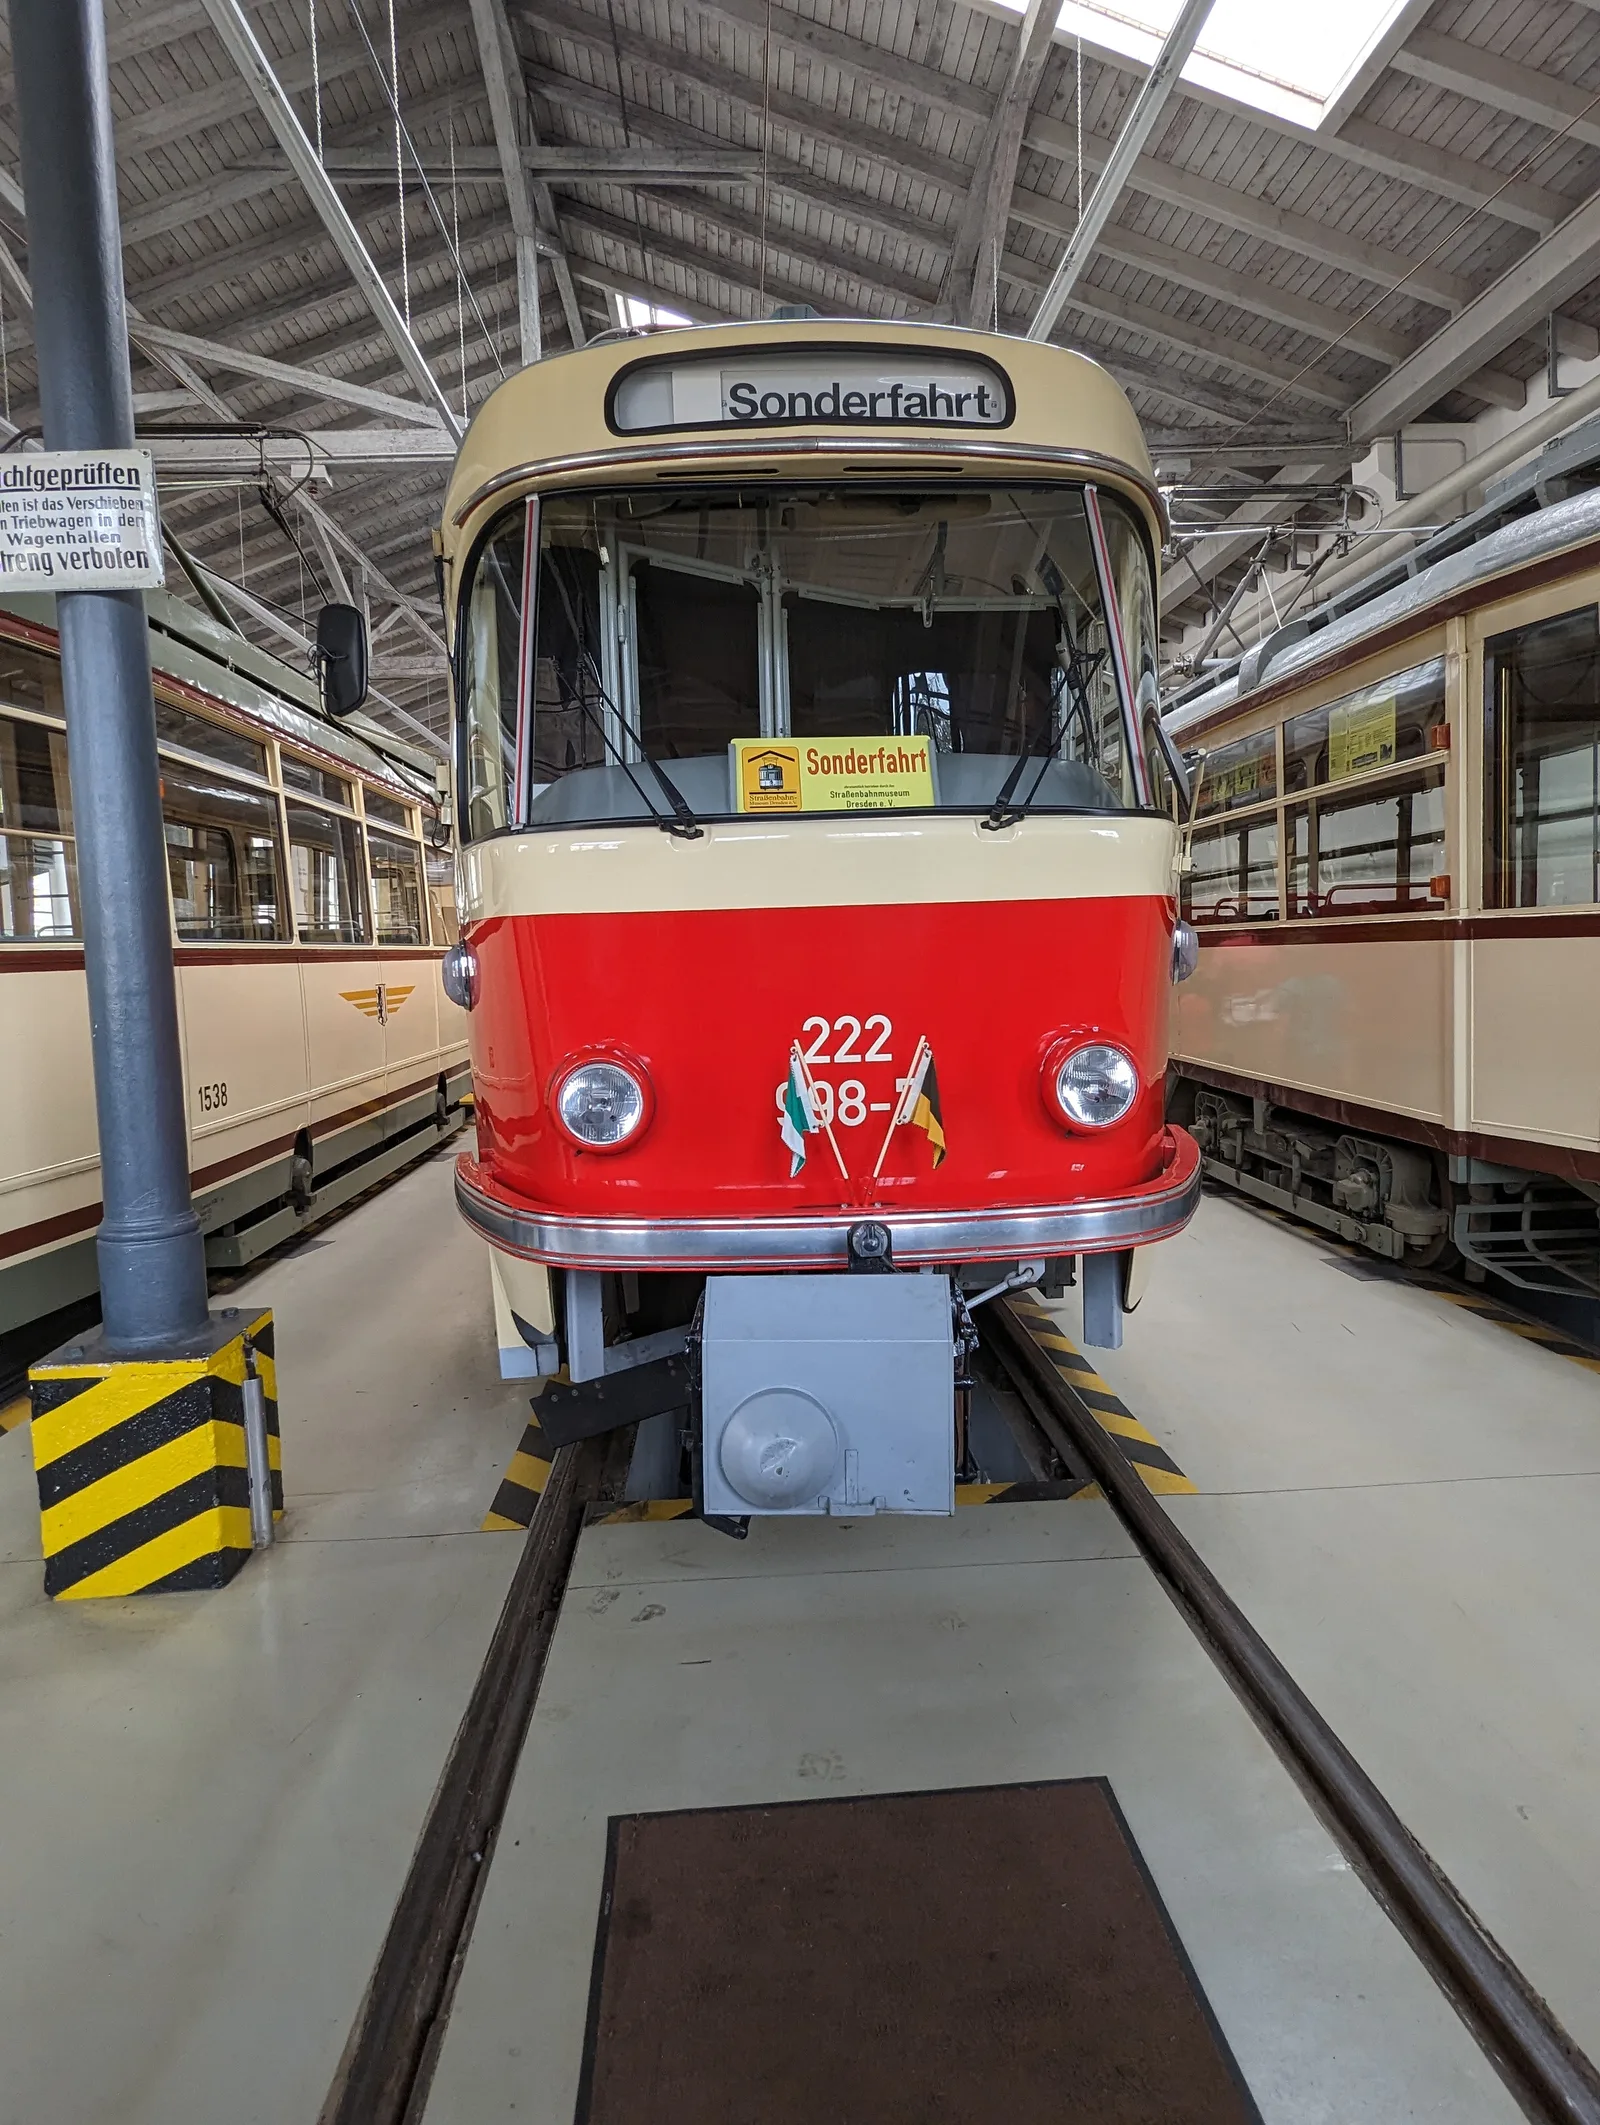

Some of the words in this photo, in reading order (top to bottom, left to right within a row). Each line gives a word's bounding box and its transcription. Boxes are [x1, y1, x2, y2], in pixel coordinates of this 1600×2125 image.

[728, 382, 991, 419] Sonderfahrt
[0, 461, 141, 492] chtgeprüften
[0, 497, 19, 513] ten
[22, 498, 38, 512] ist
[42, 496, 64, 511] das
[66, 495, 144, 511] Verschieben
[11, 514, 93, 532] Triebwagen
[98, 513, 113, 528] in
[6, 530, 122, 548] Wagenhallen
[57, 546, 150, 571] verboten
[806, 746, 927, 775] Sonderfahrt
[749, 794, 797, 802] Straßenbahn-
[829, 789, 910, 799] Straßenbahnmuseum
[846, 800, 878, 808] Dresden
[802, 1014, 893, 1064] 222
[198, 1082, 228, 1112] 1538
